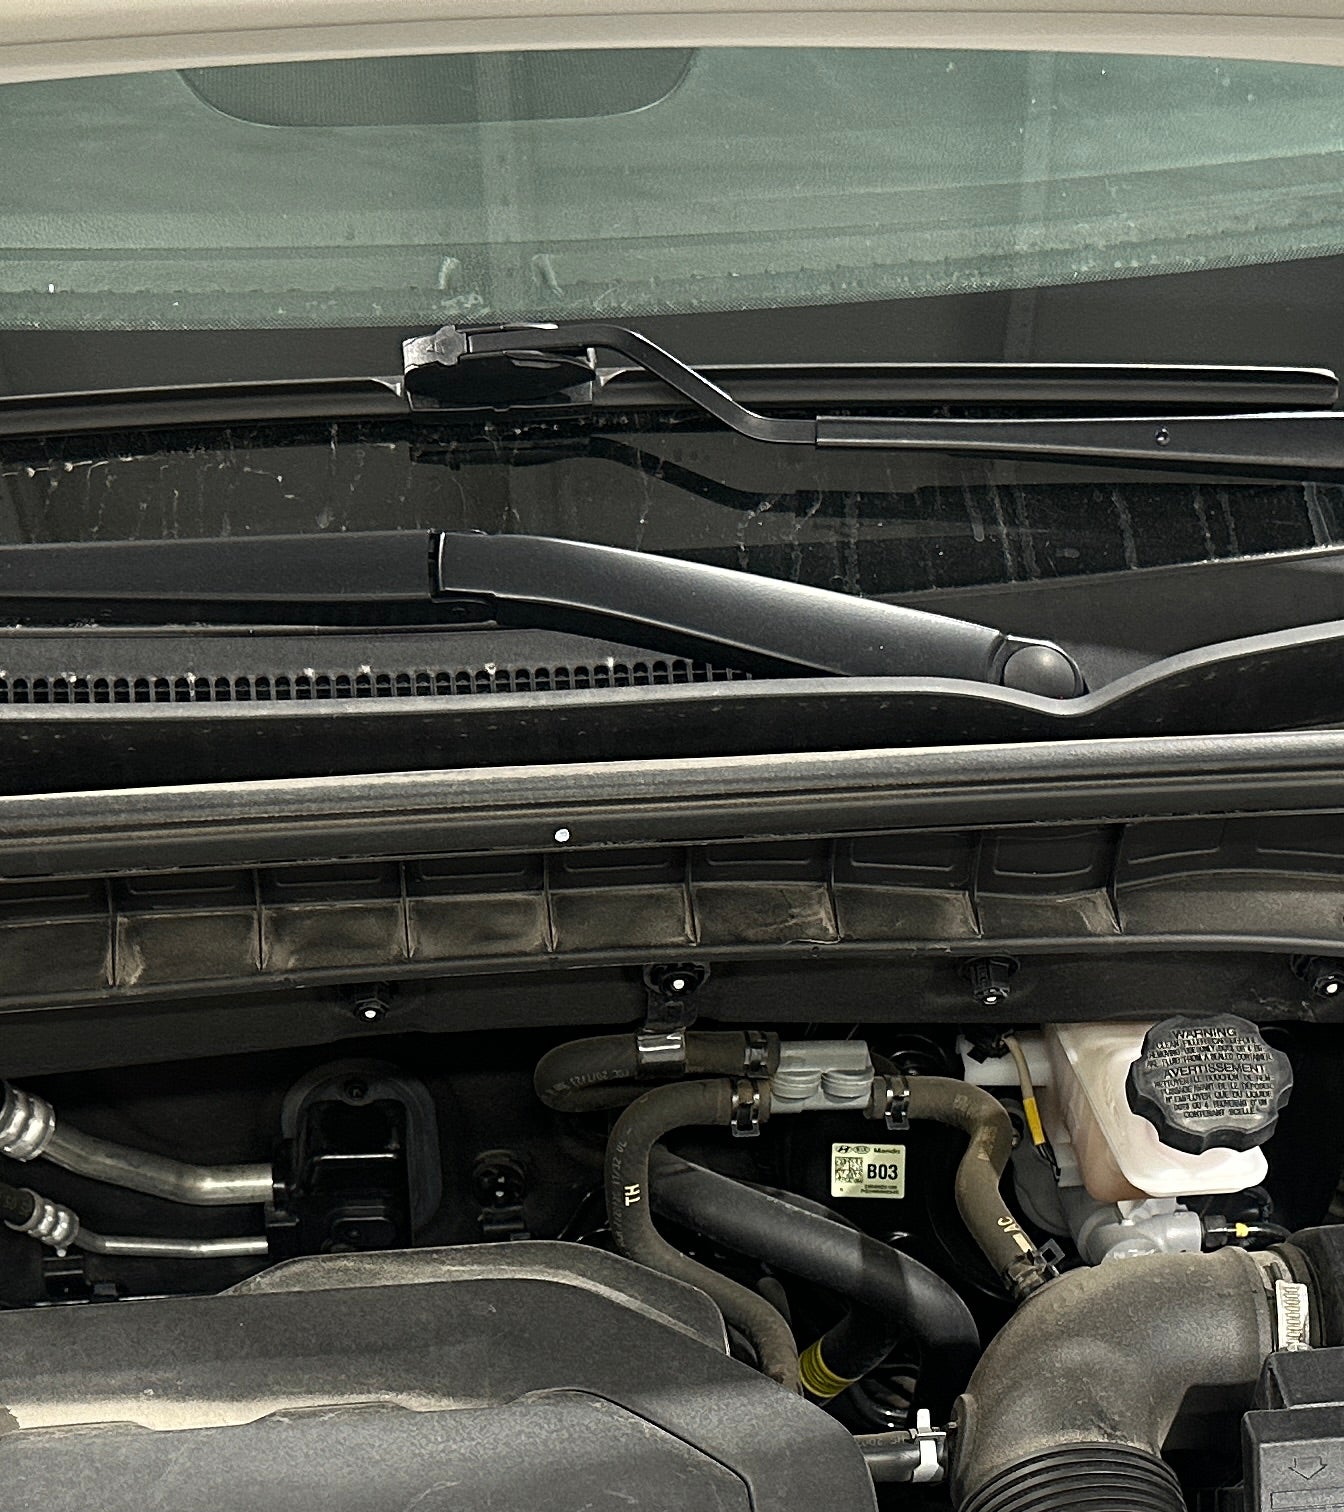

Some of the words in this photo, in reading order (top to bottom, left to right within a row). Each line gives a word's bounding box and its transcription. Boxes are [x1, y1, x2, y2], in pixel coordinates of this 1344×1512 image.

[1172, 1027, 1236, 1039] WARNING
[1164, 1062, 1267, 1078] AVERTISSEMENT
[867, 1163, 899, 1180] B03
[623, 1182, 641, 1207] TH
[997, 1216, 1021, 1232] AC
